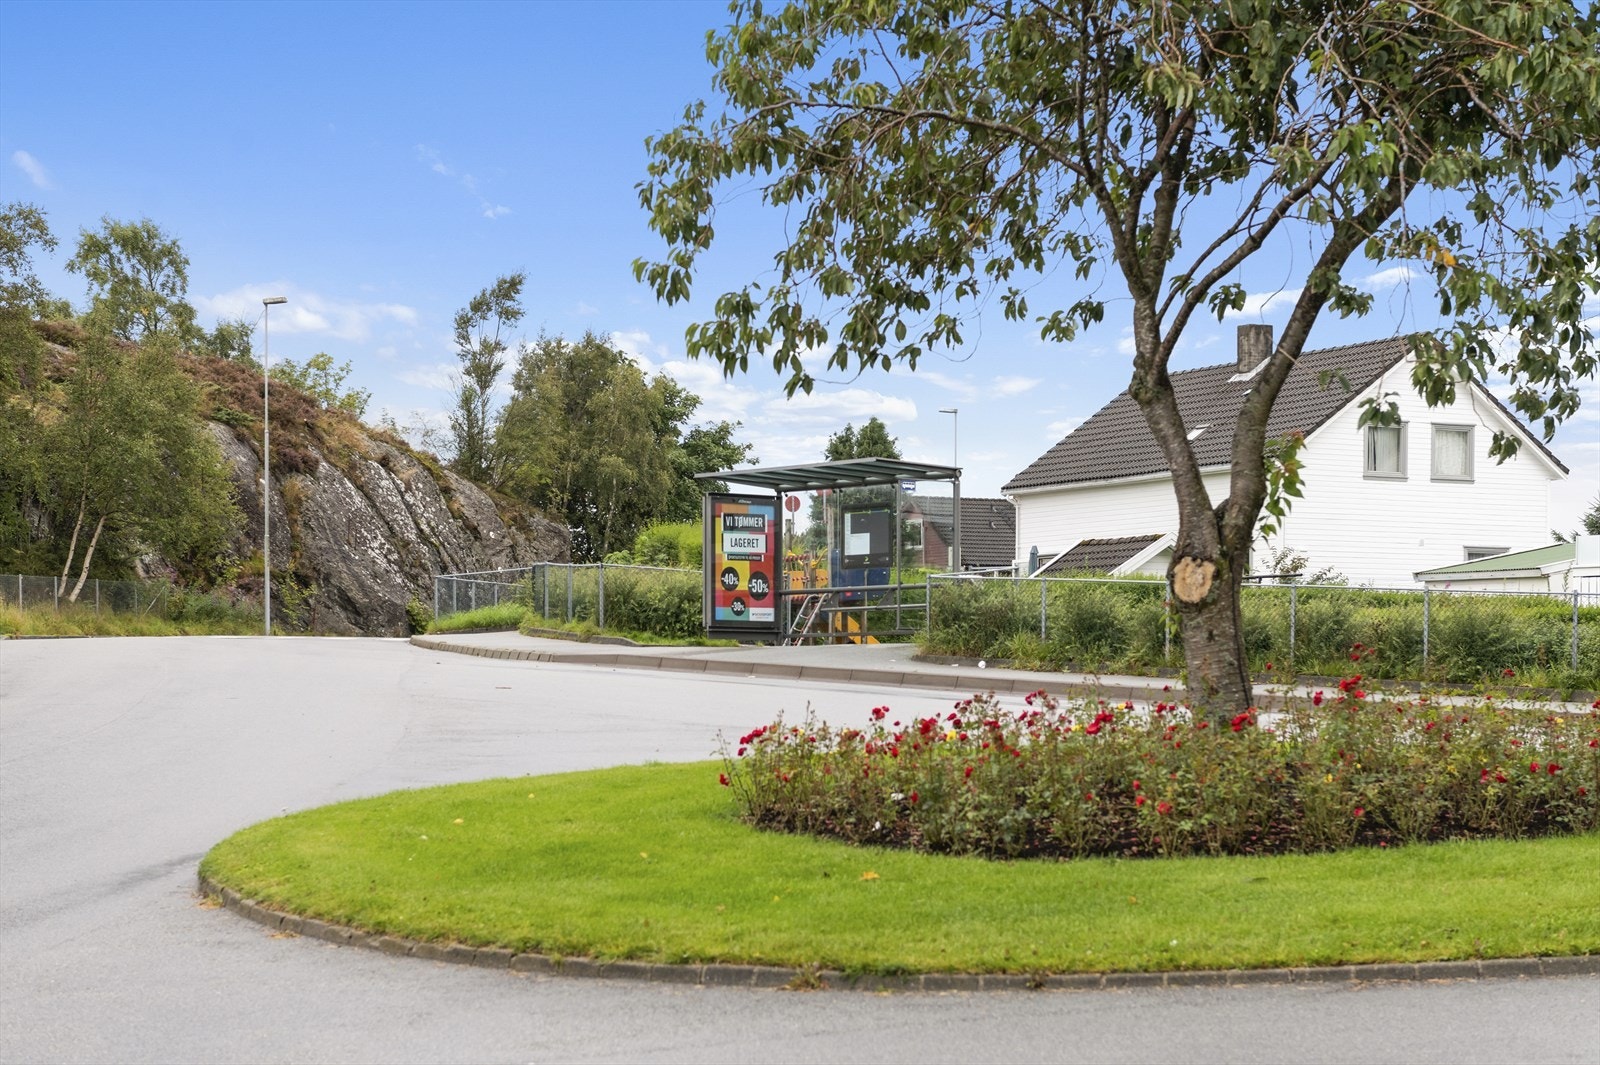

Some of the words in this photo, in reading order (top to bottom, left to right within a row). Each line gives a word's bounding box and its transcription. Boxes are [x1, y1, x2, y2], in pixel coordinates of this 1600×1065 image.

[725, 515, 733, 526] VI
[735, 515, 764, 528] TØMMER
[730, 537, 760, 549] LAGERET
[721, 573, 739, 586] -40%
[748, 579, 769, 593] -50%
